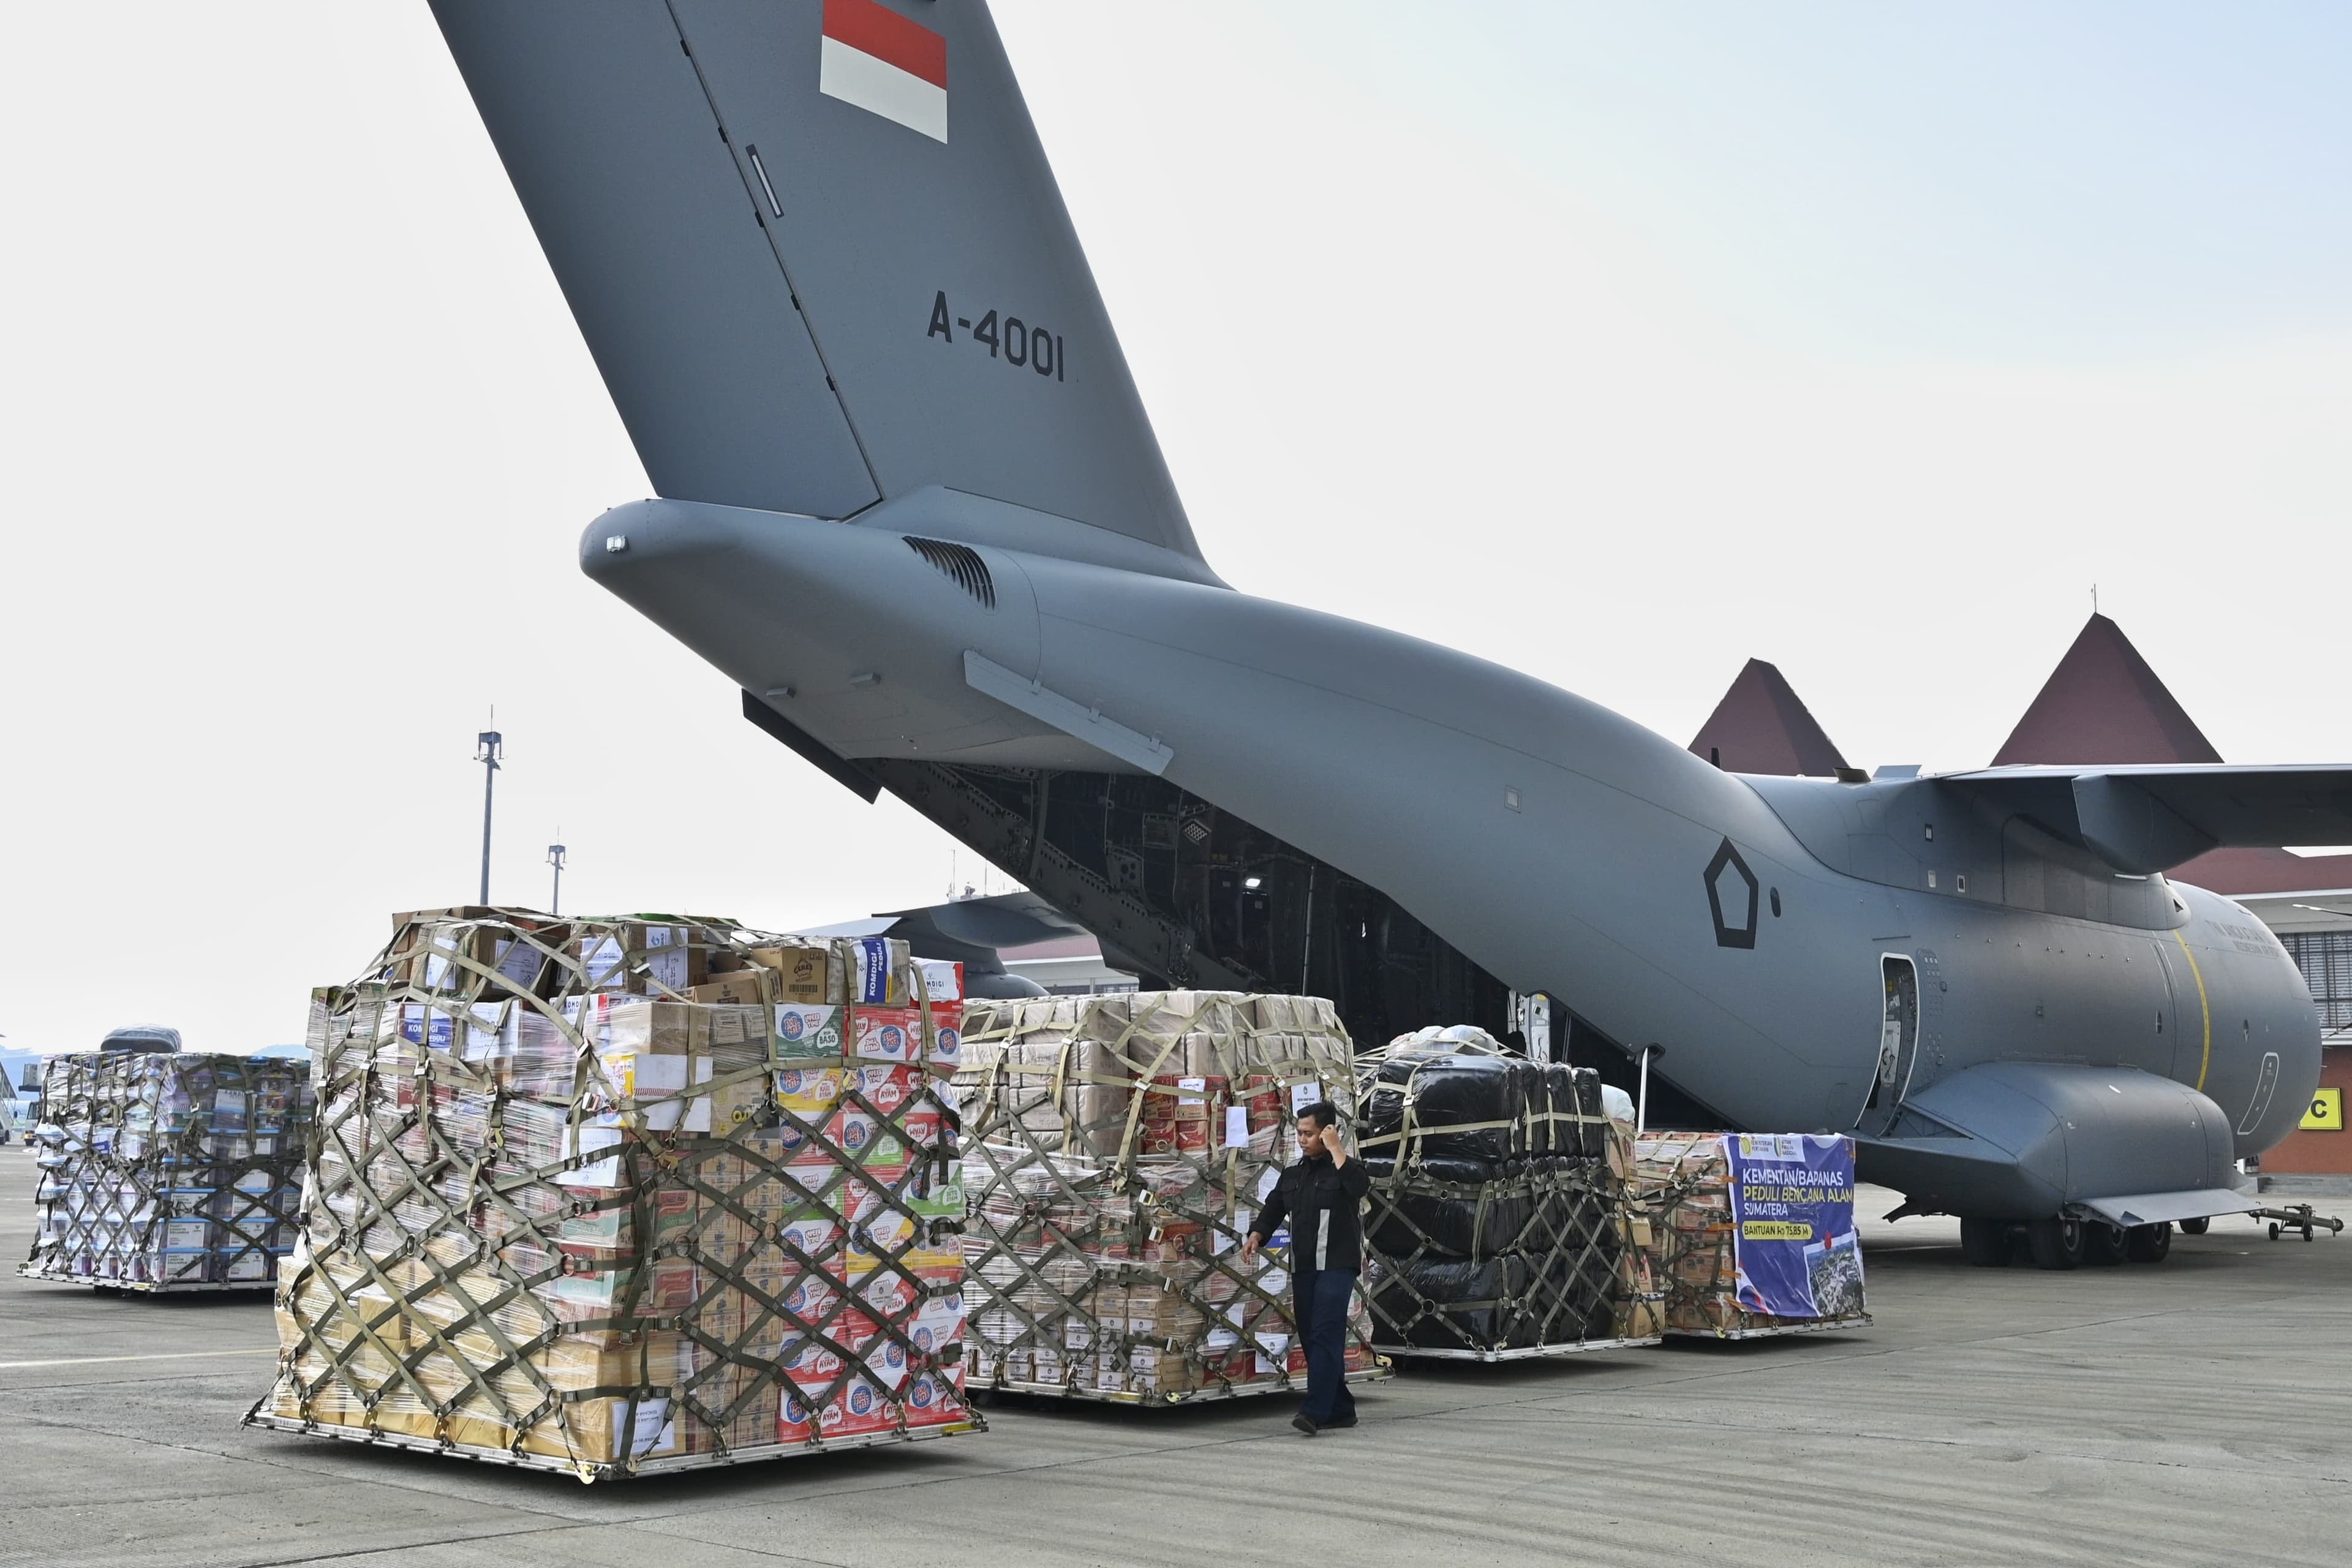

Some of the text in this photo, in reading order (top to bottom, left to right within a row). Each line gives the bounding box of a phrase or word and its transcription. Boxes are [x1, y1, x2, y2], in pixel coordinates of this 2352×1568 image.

[927, 290, 1064, 382] A-4001
[408, 1024, 438, 1033] KOMIGI
[820, 1035, 835, 1044] BASO
[881, 1089, 897, 1098] AYAM
[2311, 1099, 2327, 1118] C
[1743, 1168, 1844, 1186] KEMENTAN/BAPANAS
[1743, 1186, 1853, 1203] PEDULI BENCANA ALAM
[1744, 1203, 1789, 1216] SUMATERA
[1744, 1226, 1776, 1235] BANTUAN
[819, 1357, 836, 1368] AYAM
[823, 1411, 838, 1422] AYAM
